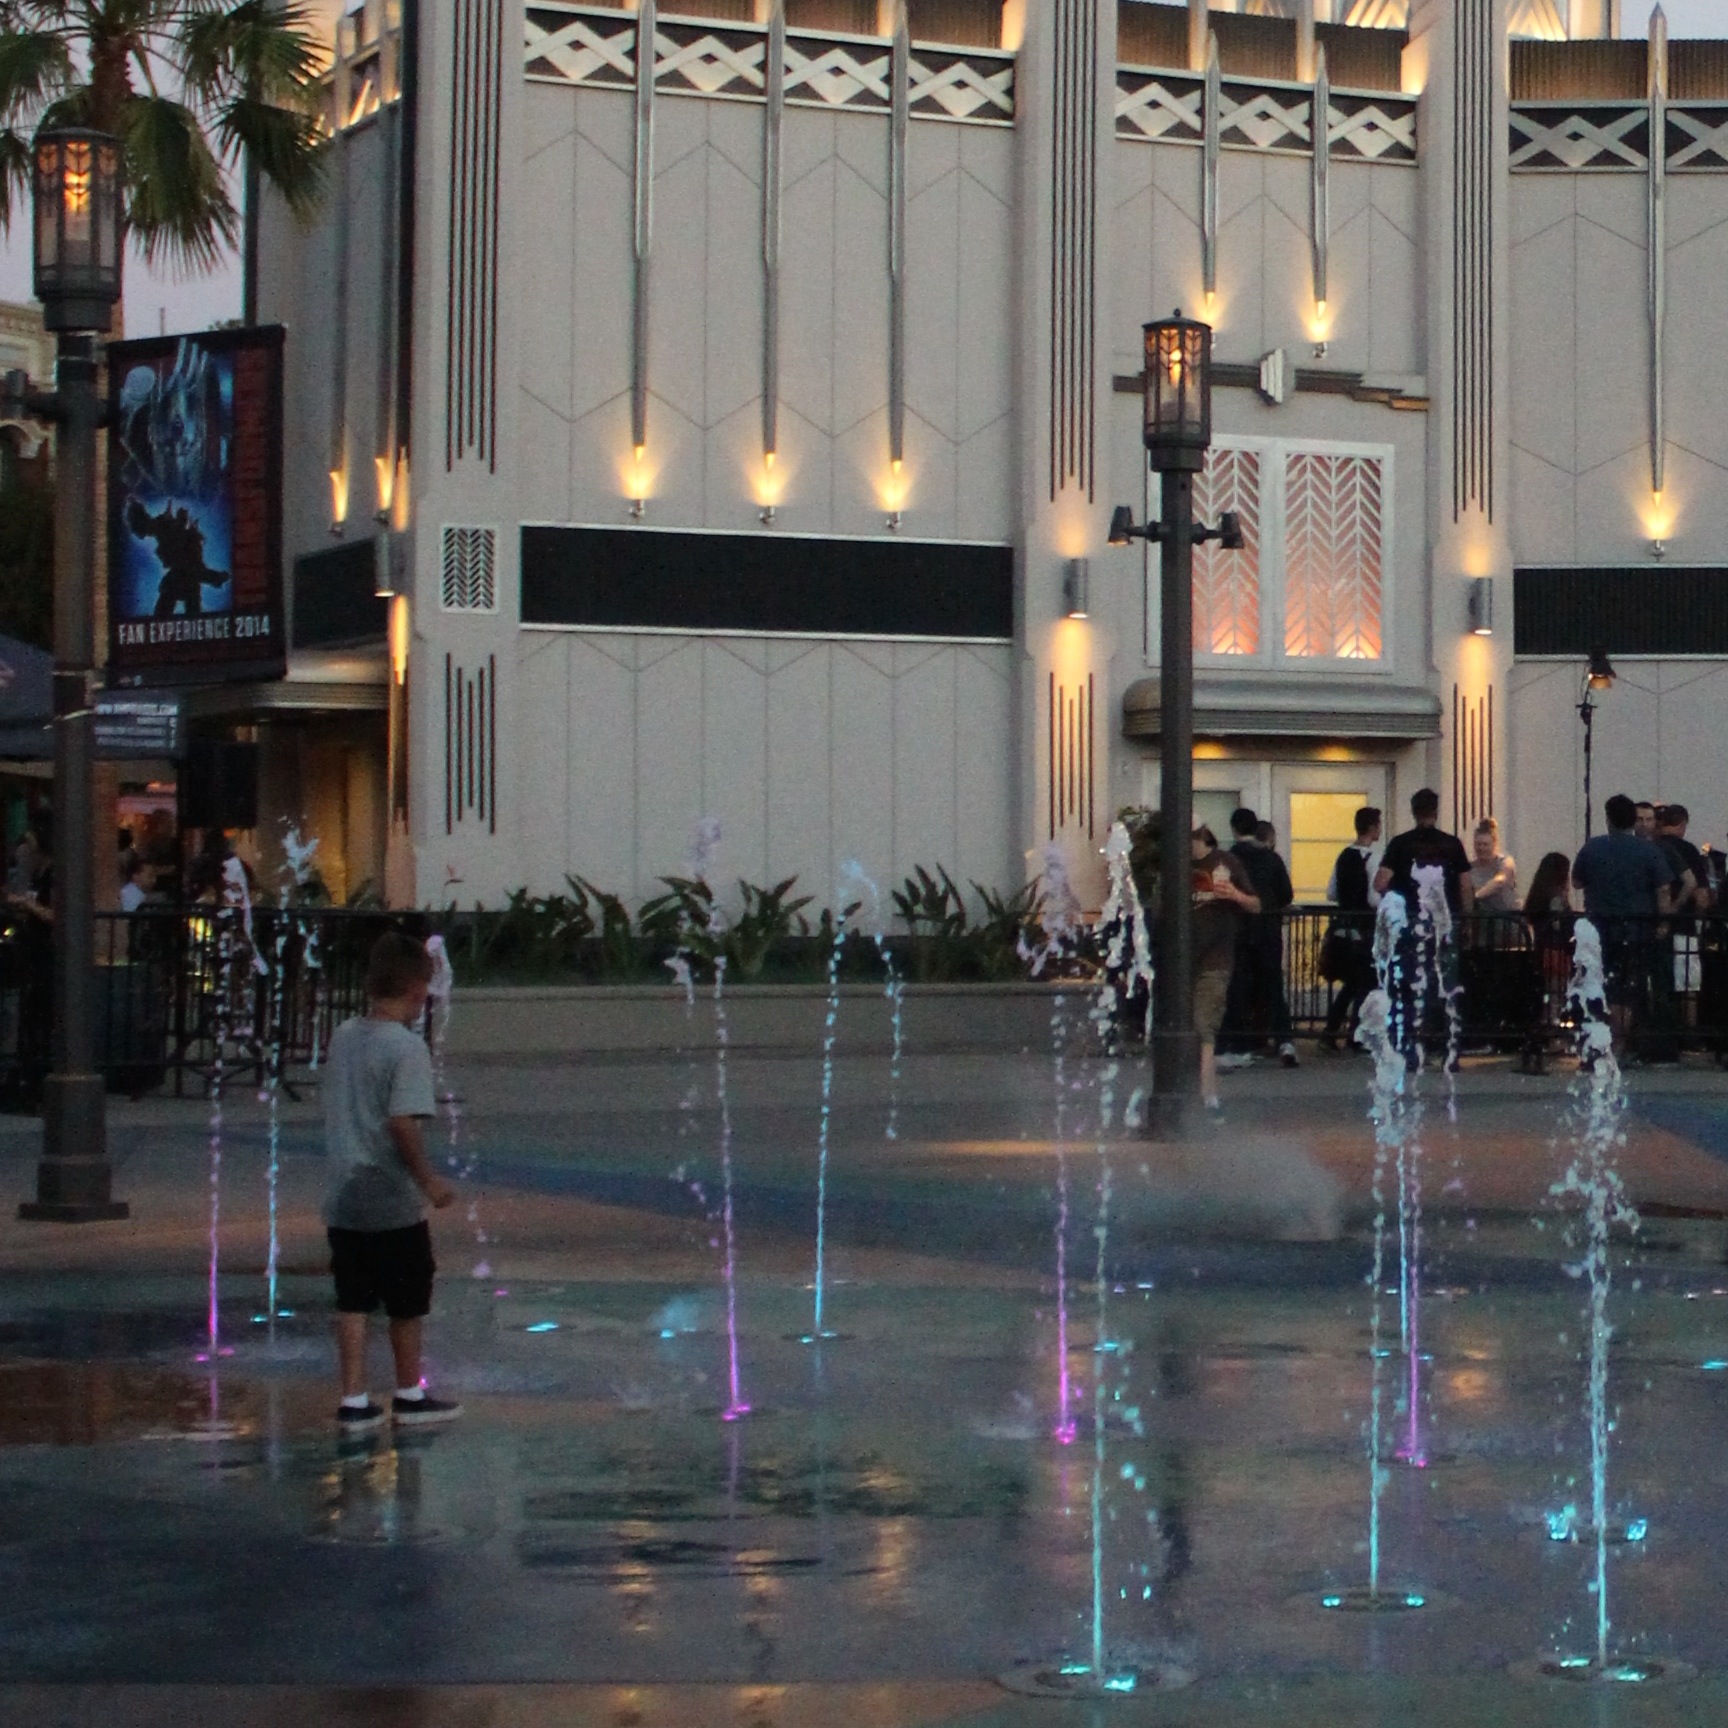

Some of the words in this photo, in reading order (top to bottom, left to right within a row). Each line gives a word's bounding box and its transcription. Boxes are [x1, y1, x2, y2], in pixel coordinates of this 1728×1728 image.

[117, 623, 145, 645] FAN
[150, 617, 230, 644] EXPERIENCE
[235, 614, 270, 638] 2014
